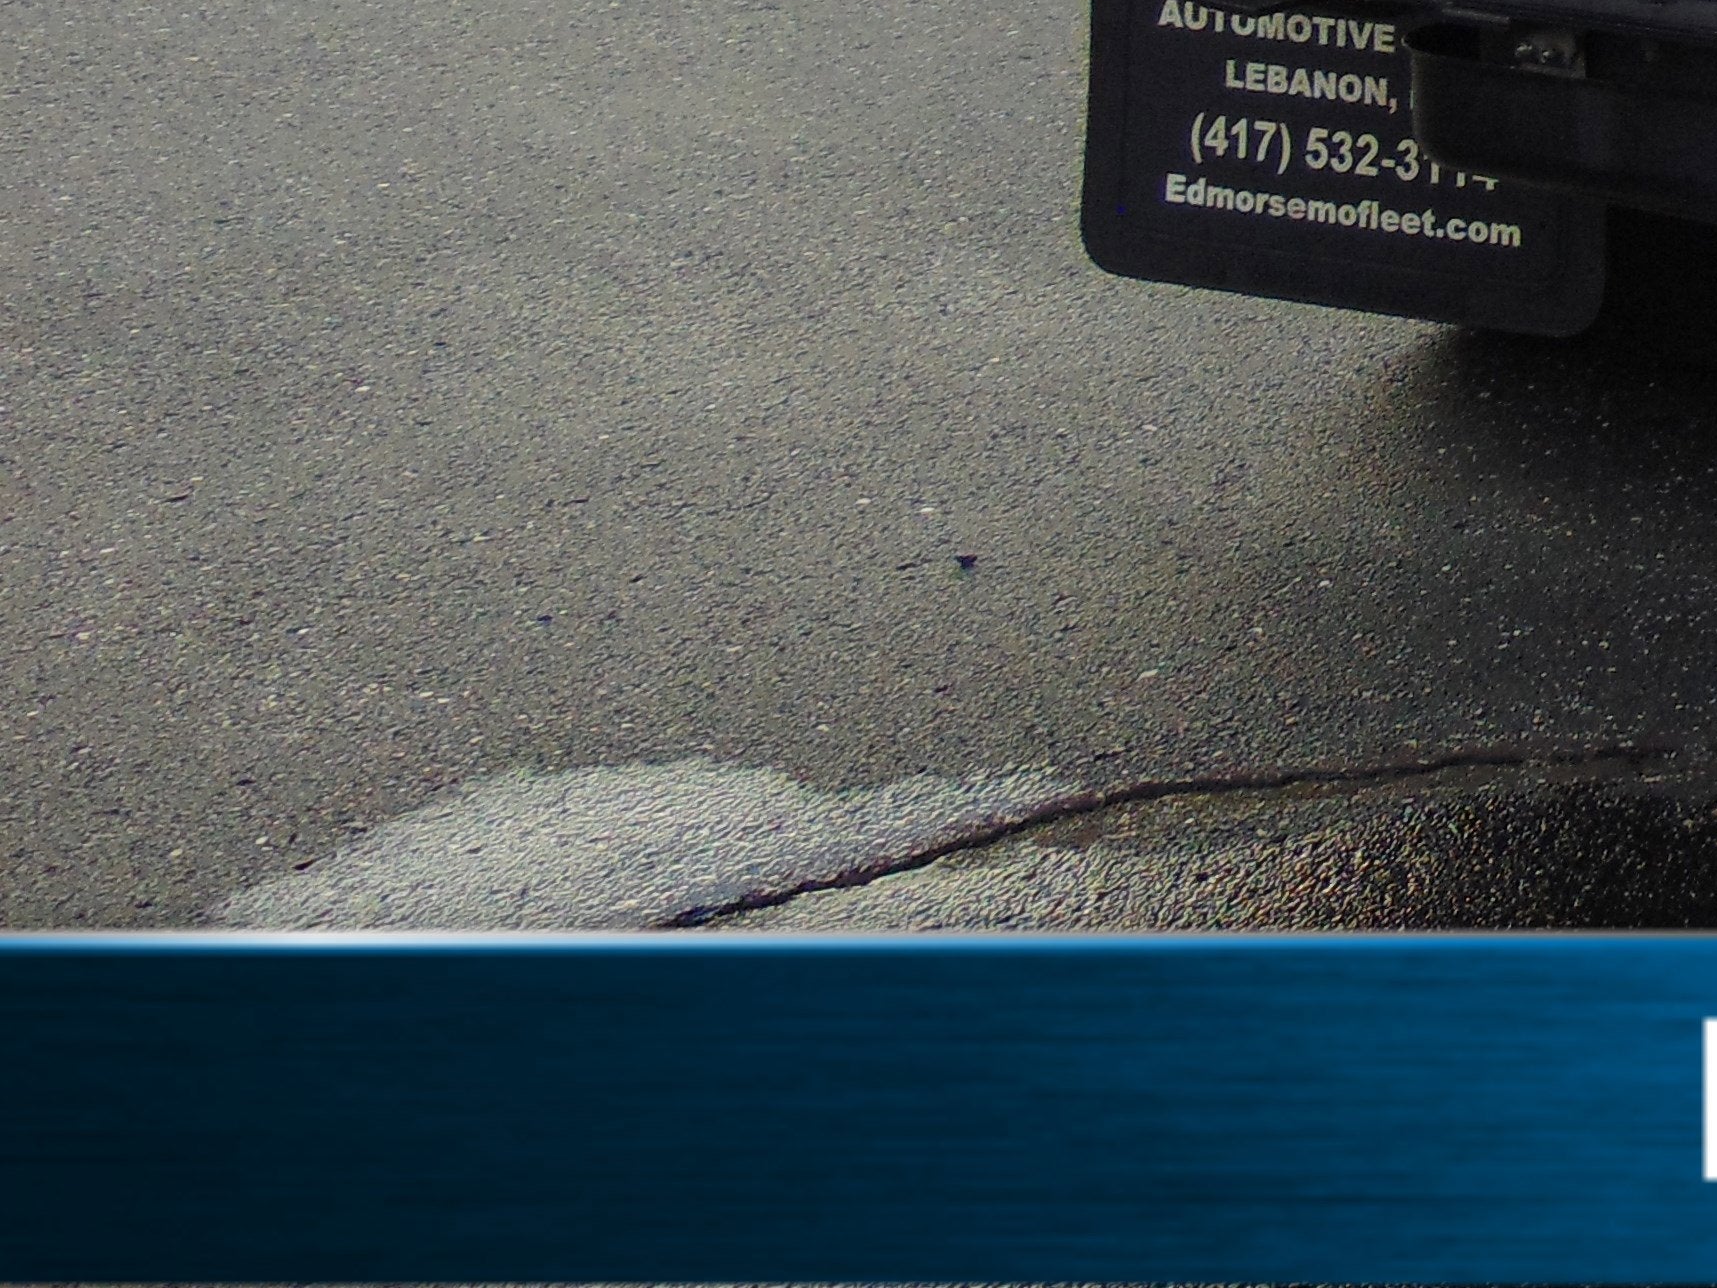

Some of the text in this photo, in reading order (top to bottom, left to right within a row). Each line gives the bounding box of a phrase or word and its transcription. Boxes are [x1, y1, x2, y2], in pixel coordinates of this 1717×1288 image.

[1224, 58, 1398, 115] LEBANON,
[1189, 111, 1292, 176] (417)
[1163, 172, 1523, 249] Edmorsemofleet.com
